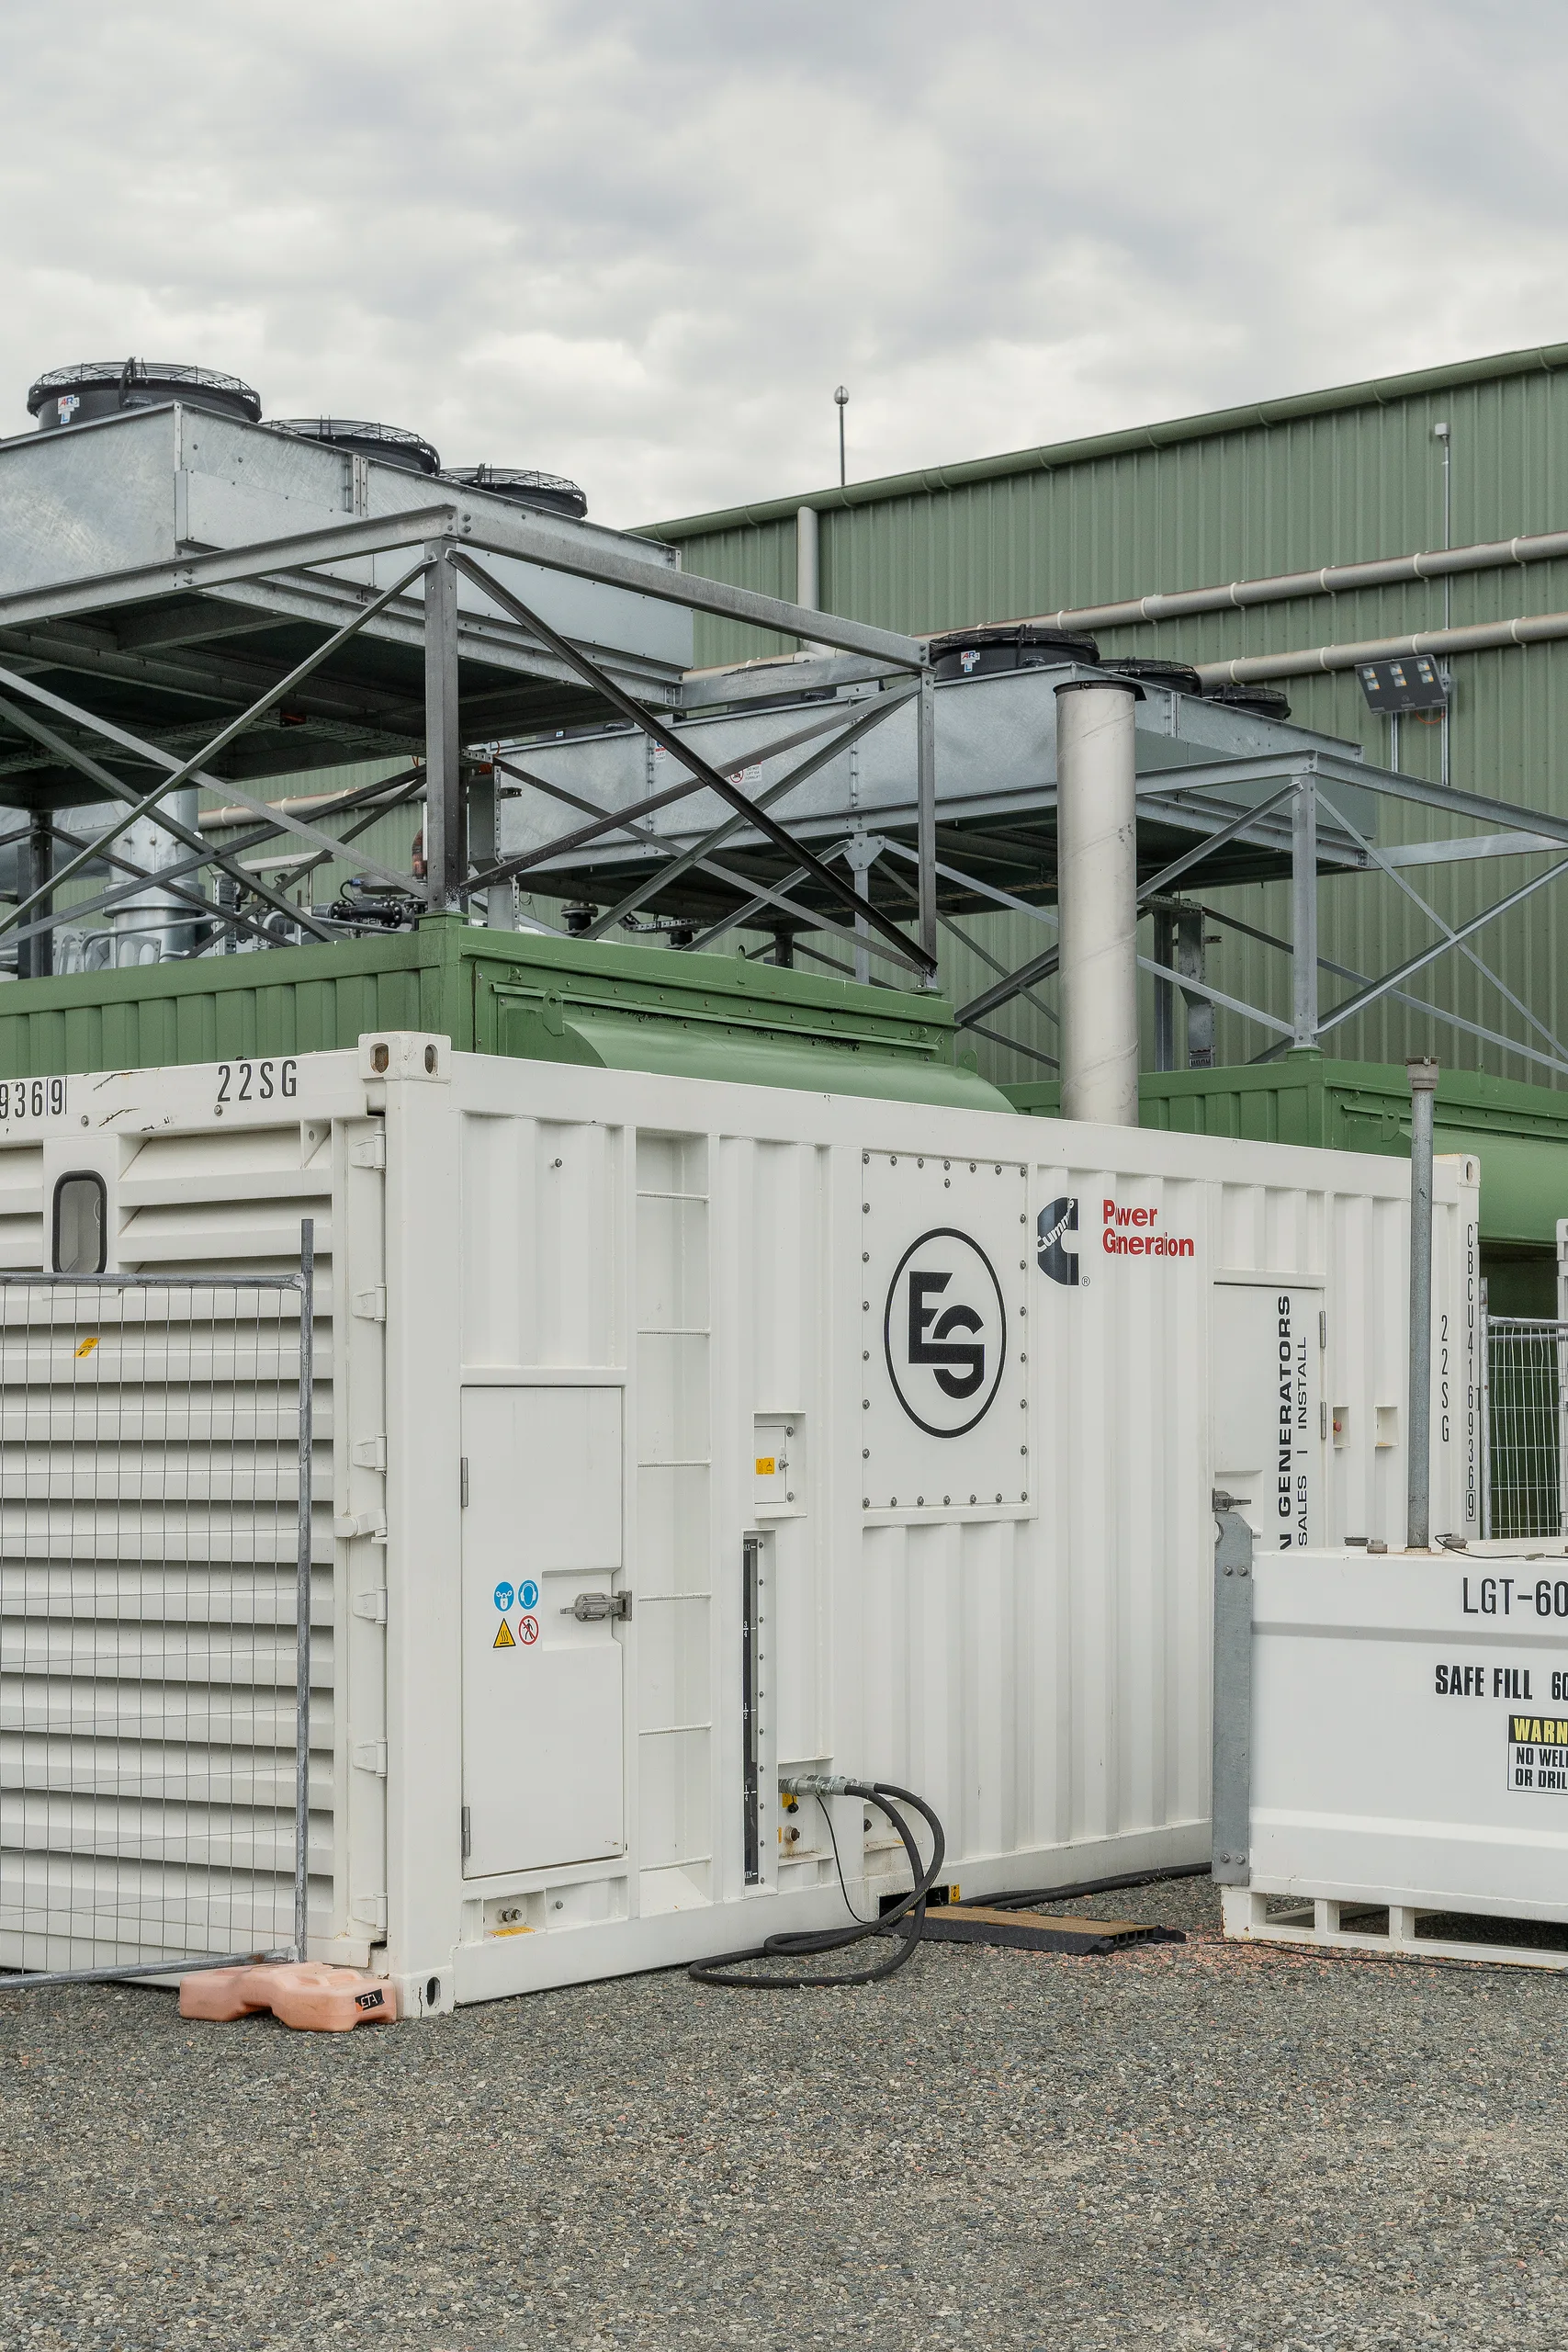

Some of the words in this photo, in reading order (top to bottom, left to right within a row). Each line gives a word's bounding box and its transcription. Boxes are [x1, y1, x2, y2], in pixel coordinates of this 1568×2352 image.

[217, 1059, 298, 1102] 22SG
[1297, 1336, 1308, 1430] INSTALL
[1278, 1295, 1292, 1518] GENERATORS
[1297, 1475, 1308, 1546] SALES
[1462, 1577, 1568, 1617] LGT-60
[1435, 1664, 1485, 1697] SAFE
[1493, 1668, 1533, 1700] FILL
[1514, 1717, 1568, 1745] WARN
[1517, 1747, 1534, 1766] NO
[1515, 1768, 1532, 1787] OR
